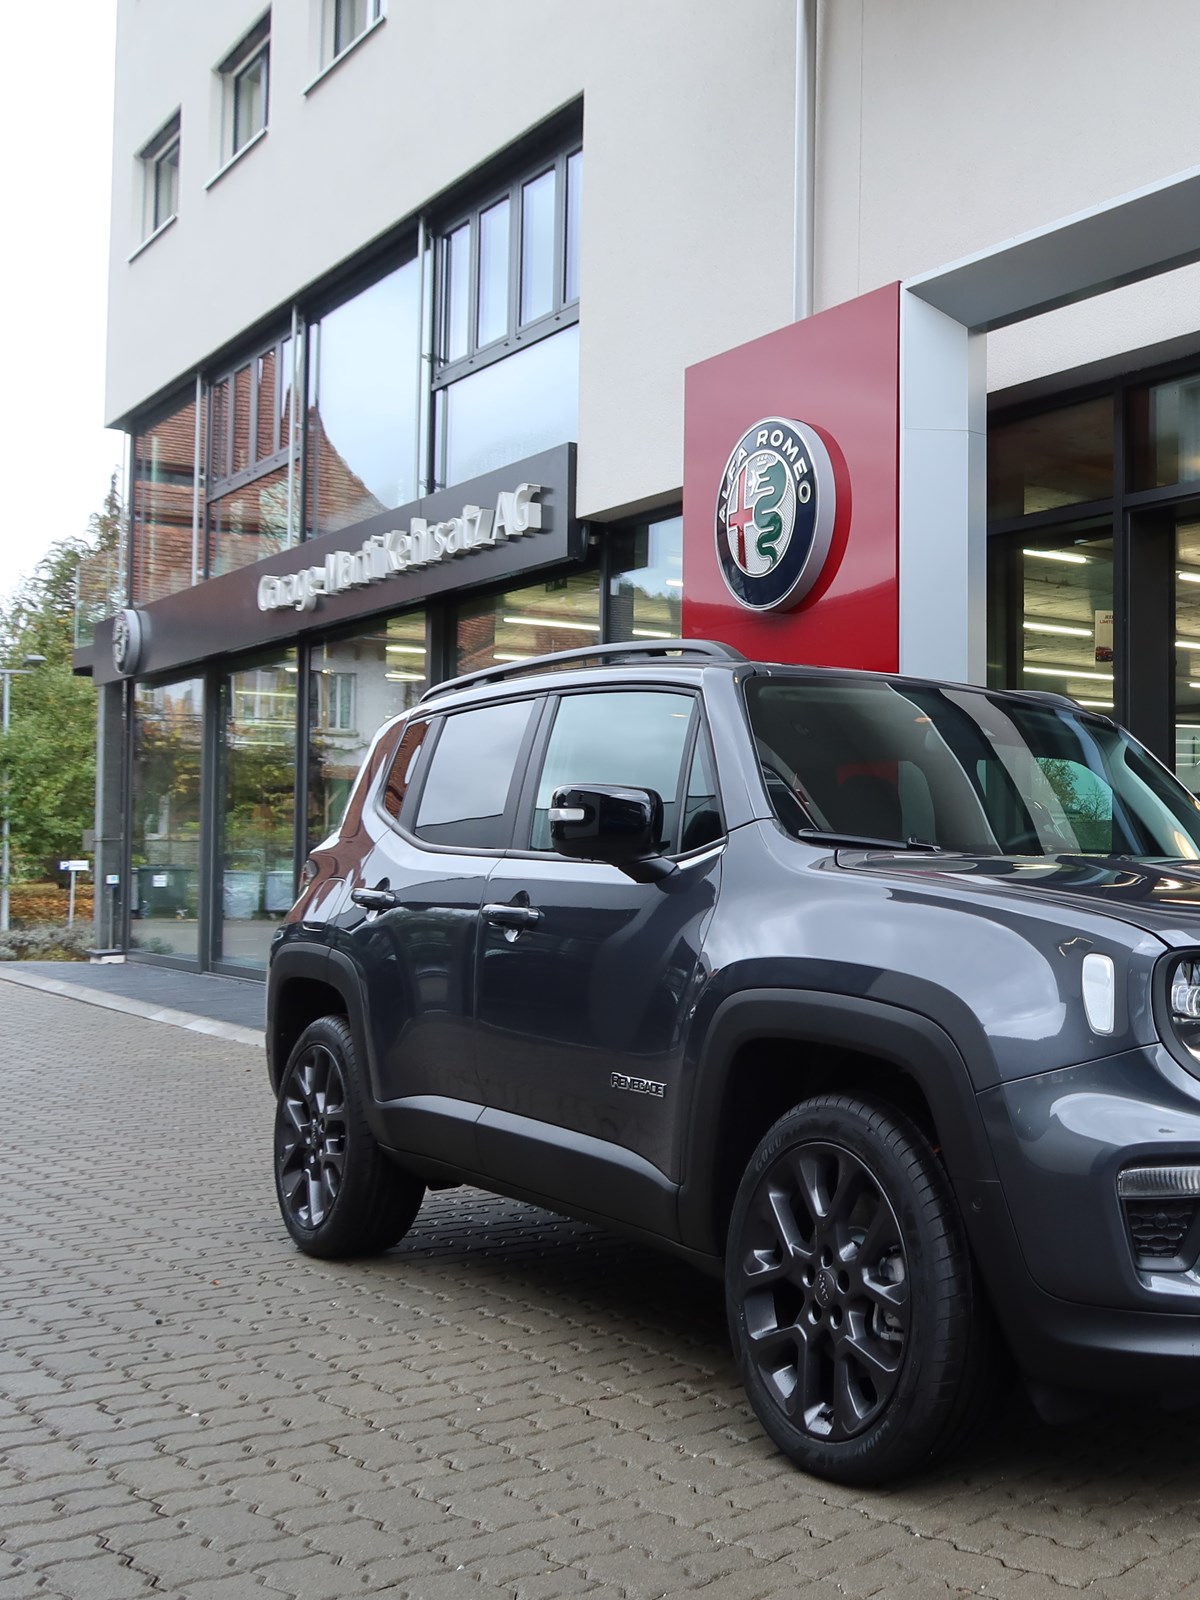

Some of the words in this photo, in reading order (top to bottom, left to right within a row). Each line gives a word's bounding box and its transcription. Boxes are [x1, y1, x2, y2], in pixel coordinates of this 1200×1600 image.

[717, 447, 749, 524] ALFA
[755, 428, 812, 504] ROMEO
[257, 565, 326, 613] Garage
[384, 503, 497, 572] Kehrsatz
[492, 482, 542, 541] AG
[610, 1071, 667, 1098] RENEGADE
